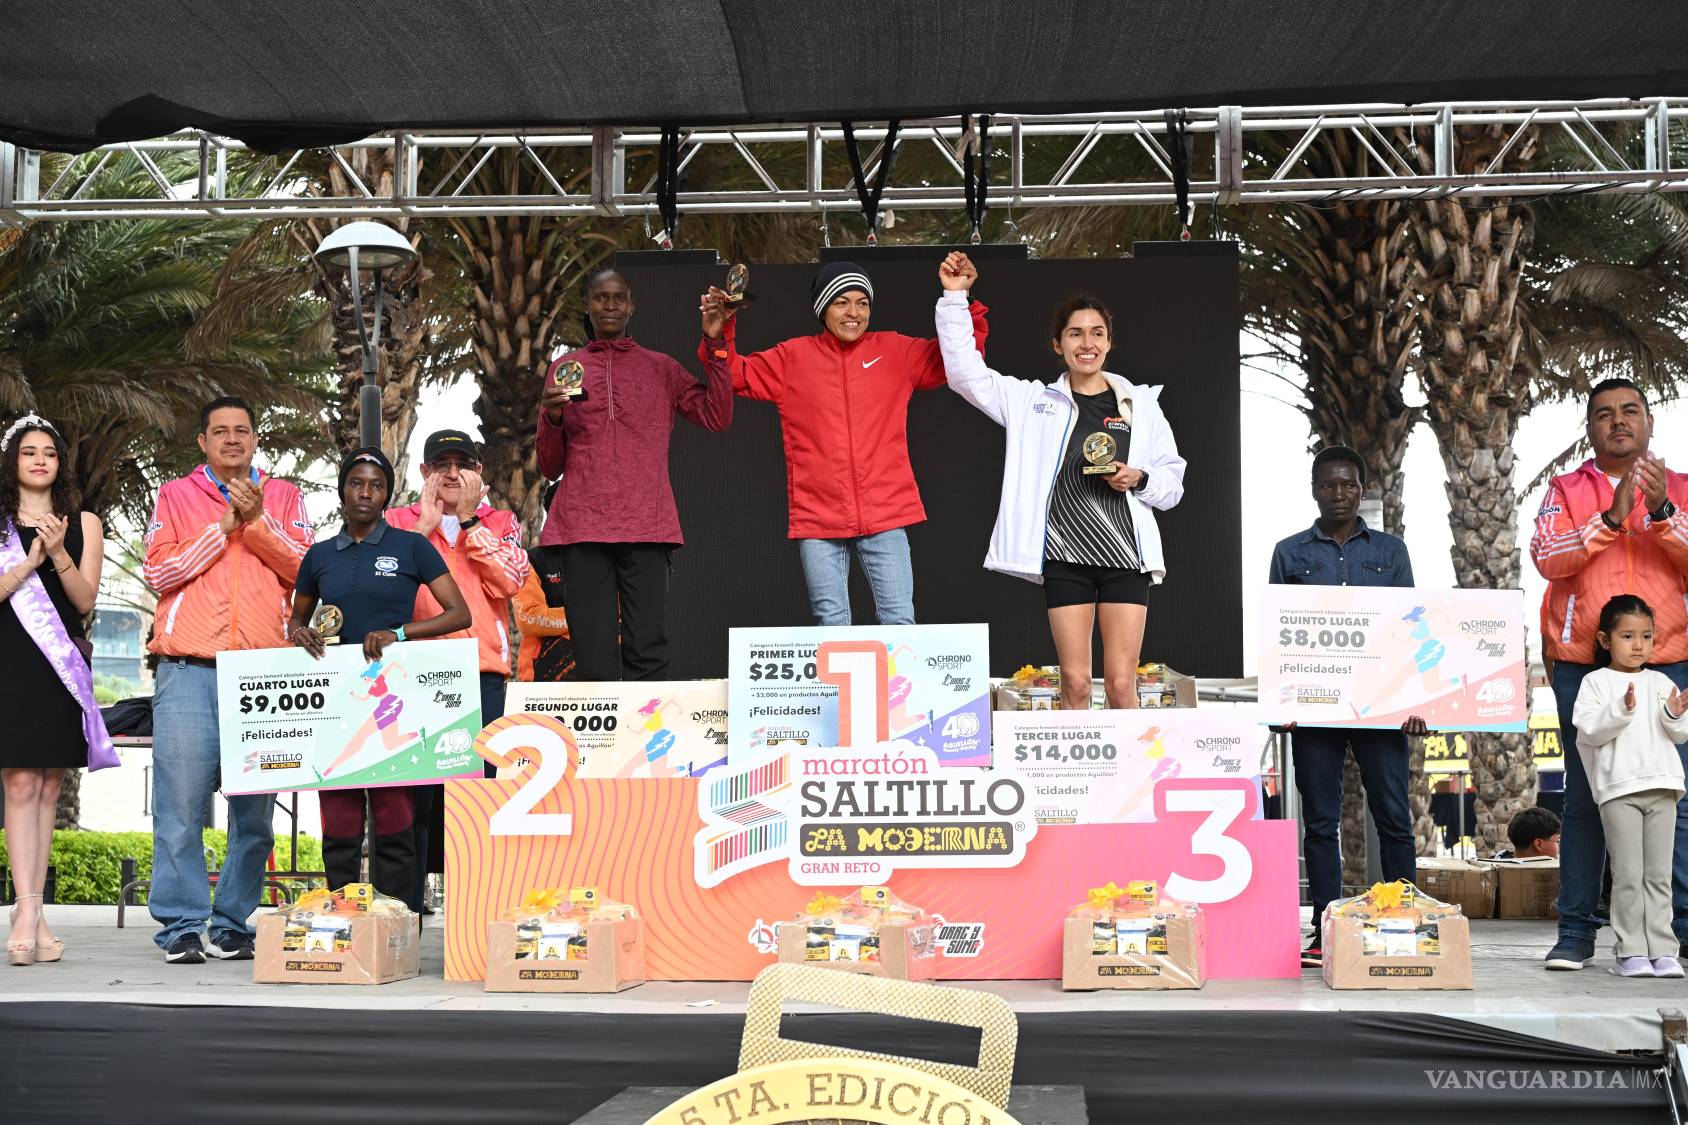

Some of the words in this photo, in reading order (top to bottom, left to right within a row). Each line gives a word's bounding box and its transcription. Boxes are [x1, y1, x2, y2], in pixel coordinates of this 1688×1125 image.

[1280, 616, 1327, 625] QUINTO
[1330, 617, 1369, 627] LUGAR
[1471, 620, 1506, 628] CHRONO
[1471, 627, 1497, 635] SPORT
[1279, 627, 1365, 649] $8,000
[750, 650, 795, 659] PRIMER
[937, 654, 971, 662] CHRONO
[749, 662, 817, 682] $25,0
[937, 662, 962, 670] SPORT
[1280, 662, 1352, 674] ¡Felicidades!
[427, 671, 462, 680] CHRONO
[239, 680, 288, 691] CUARTO
[291, 678, 330, 688] LUGAR
[427, 678, 453, 687] SPORT
[1297, 687, 1340, 696] SALTILLO
[239, 692, 325, 714] $9,000
[828, 651, 877, 747] 1
[524, 703, 578, 711] SEGUNDO
[581, 703, 618, 711] LUGAR
[750, 706, 821, 718] ¡Felicidades!
[241, 728, 313, 742] ¡Felicidades!
[767, 730, 810, 739] SALTILLO
[1014, 732, 1058, 740] TERCER
[1062, 732, 1101, 740] LUGAR
[260, 753, 303, 763] SALTILLO
[1014, 744, 1117, 763] $14,000
[802, 751, 928, 775] maratón
[489, 725, 573, 836] 2
[801, 778, 1025, 818] SALTILLO
[1034, 809, 1078, 817] SALTILLO
[857, 827, 1008, 851] MODERNA
[1164, 789, 1254, 900] 3
[800, 863, 841, 874] GRAN
[844, 862, 881, 873] RETO
[713, 1080, 790, 1124] TA.
[806, 1073, 992, 1125] EDICIÓ
